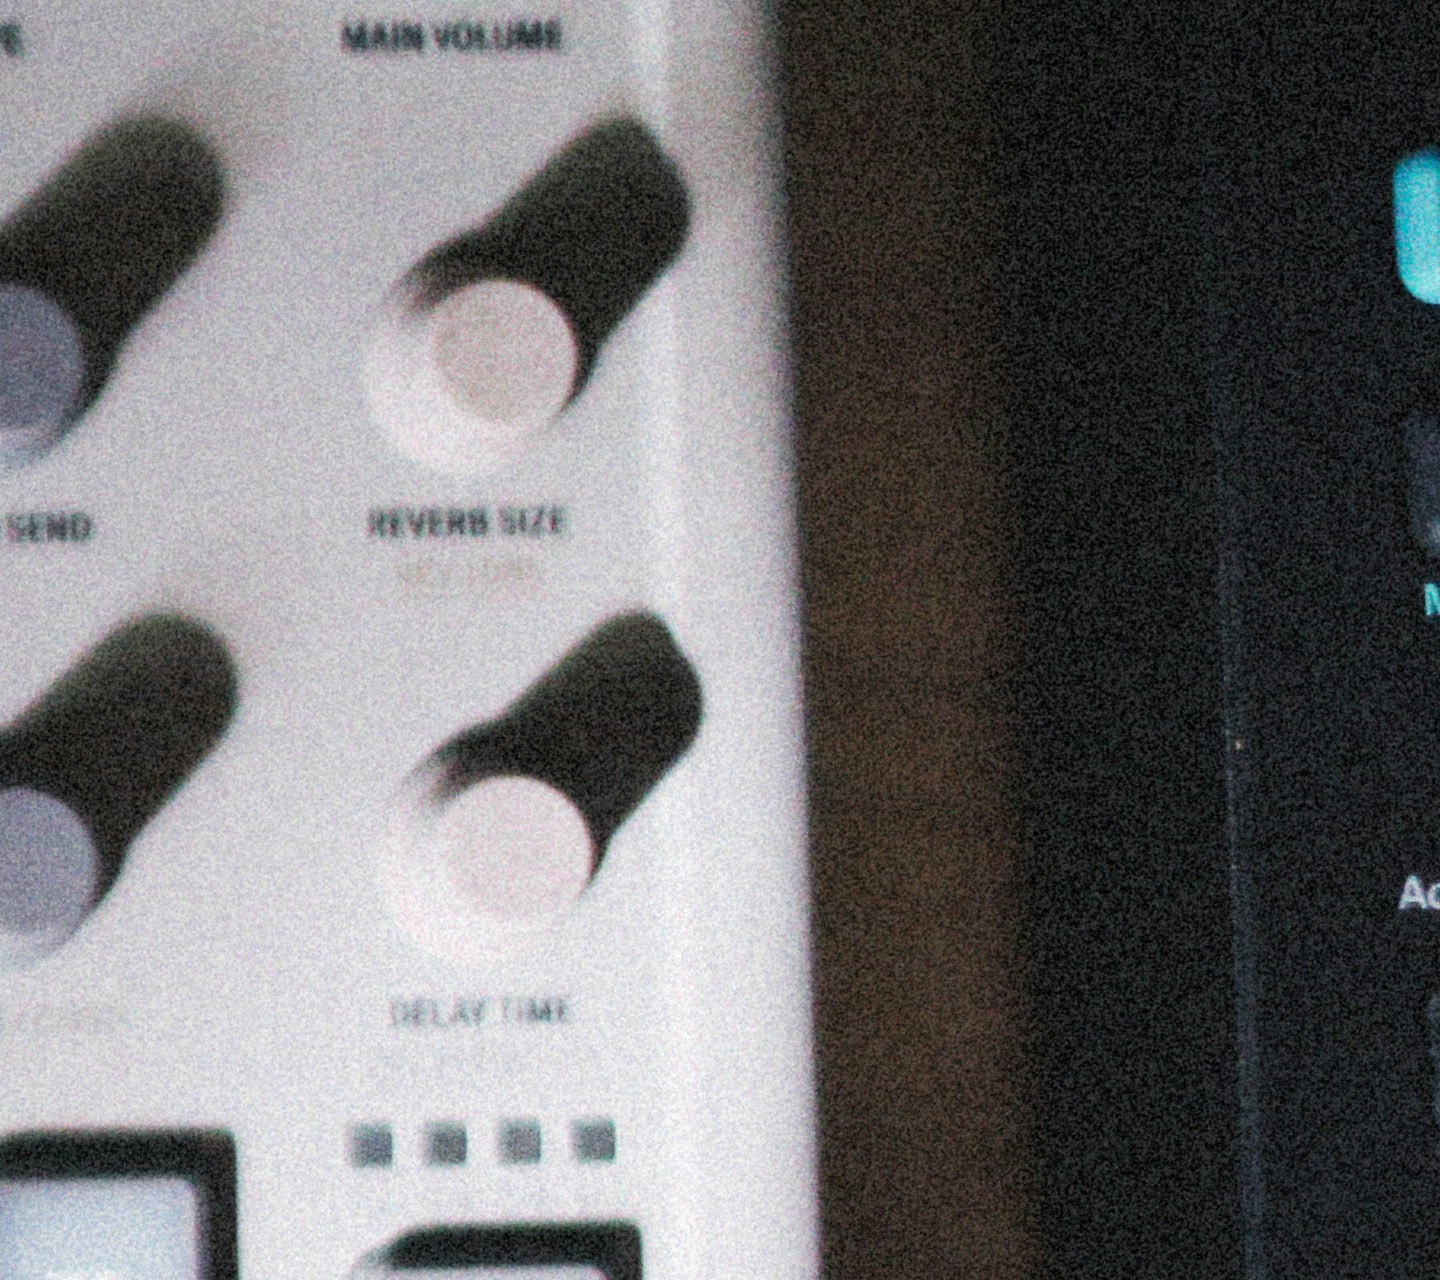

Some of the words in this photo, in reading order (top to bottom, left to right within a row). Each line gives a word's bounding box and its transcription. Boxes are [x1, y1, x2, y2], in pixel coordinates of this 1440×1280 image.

[341, 22, 423, 53] MAIN
[434, 20, 562, 51] VOLUME
[7, 512, 93, 543] SEND
[367, 508, 487, 539] REVERB
[498, 505, 565, 537] SIZE
[391, 998, 487, 1028] DELAY
[501, 997, 569, 1025] TIME
